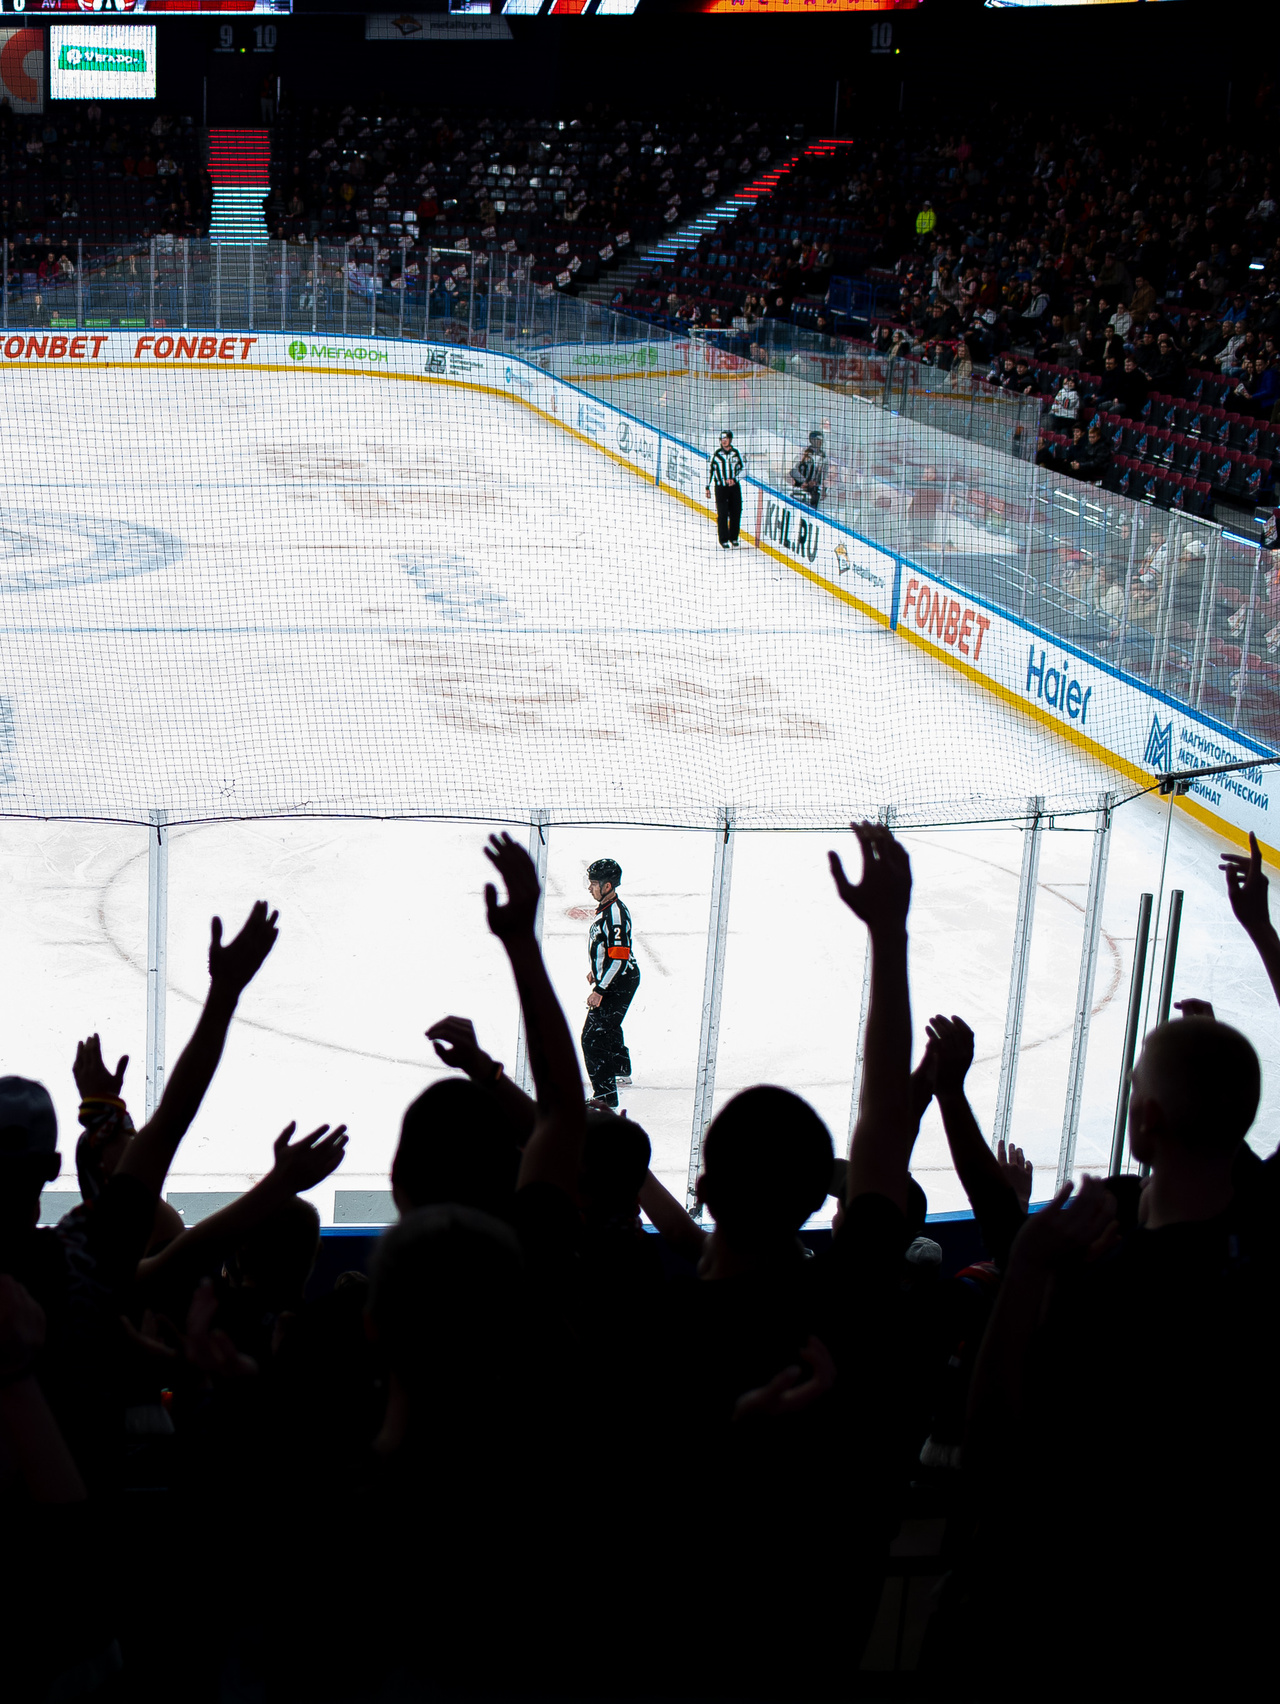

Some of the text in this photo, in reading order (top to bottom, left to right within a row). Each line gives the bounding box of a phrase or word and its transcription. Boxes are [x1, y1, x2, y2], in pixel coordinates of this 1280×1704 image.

[219, 24, 233, 47] 9
[253, 24, 277, 47] 10
[870, 22, 892, 47] 10
[133, 336, 257, 359] FONBET
[764, 499, 819, 563] KHL.RU
[903, 578, 990, 661] FONBET
[1026, 644, 1092, 725] Haier
[613, 927, 621, 939] 2
